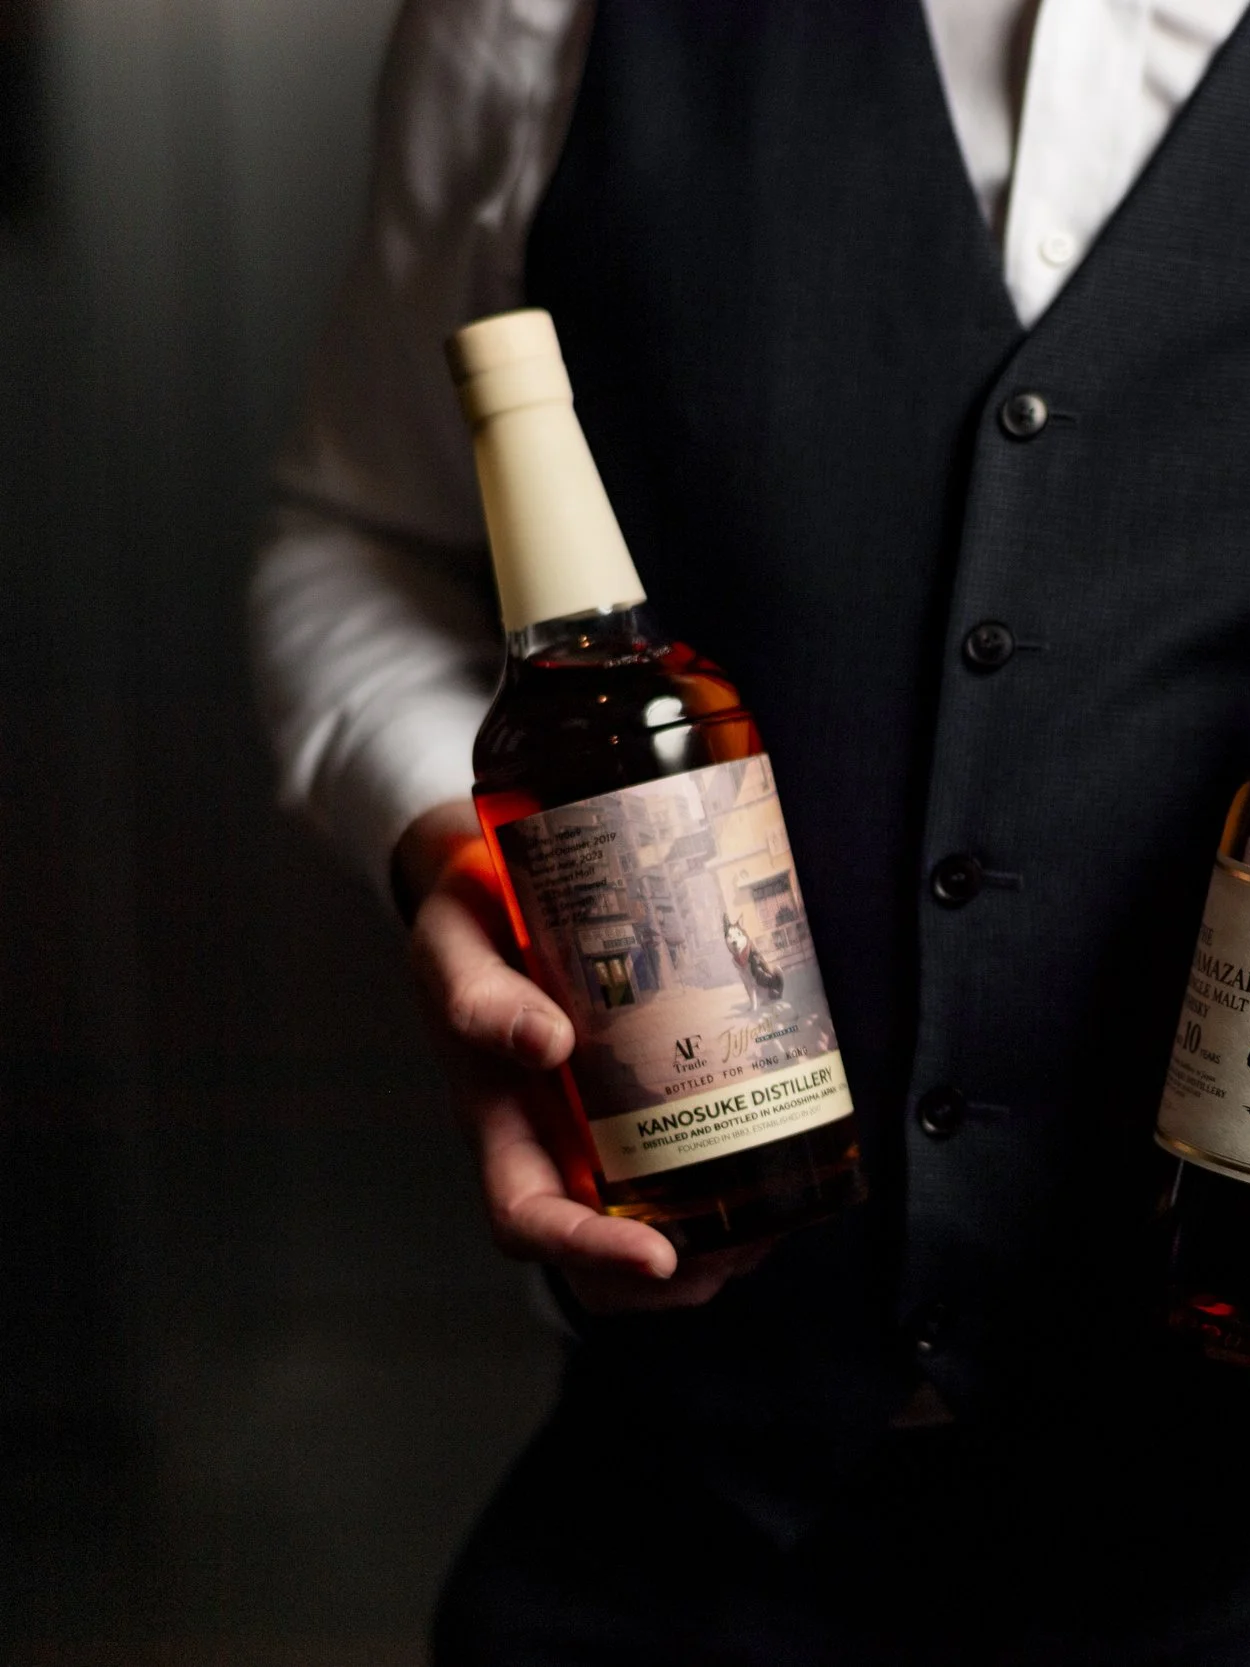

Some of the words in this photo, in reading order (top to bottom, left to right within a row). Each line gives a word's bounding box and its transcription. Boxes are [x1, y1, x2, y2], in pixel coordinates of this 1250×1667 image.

[594, 832, 616, 846] 2019
[1212, 987, 1250, 1012] MALT
[674, 1035, 703, 1062] AF
[1183, 1021, 1202, 1054] 10
[665, 1074, 714, 1095] BOTTLED
[723, 1067, 744, 1080] FOR
[752, 1055, 780, 1072] HONG
[785, 1046, 809, 1061] KONG
[672, 1058, 708, 1074] Trade
[638, 1094, 748, 1138] KANOSUKE
[752, 1066, 833, 1107] DISTILLERY
[642, 1131, 689, 1150] DISTILLED
[690, 1125, 712, 1140] AND
[714, 1111, 758, 1131] BOTTLED
[760, 1107, 771, 1119] IN
[772, 1092, 821, 1114] KAGOSHIMA
[678, 1136, 721, 1154] FOUNDED
[721, 1132, 732, 1144] IN
